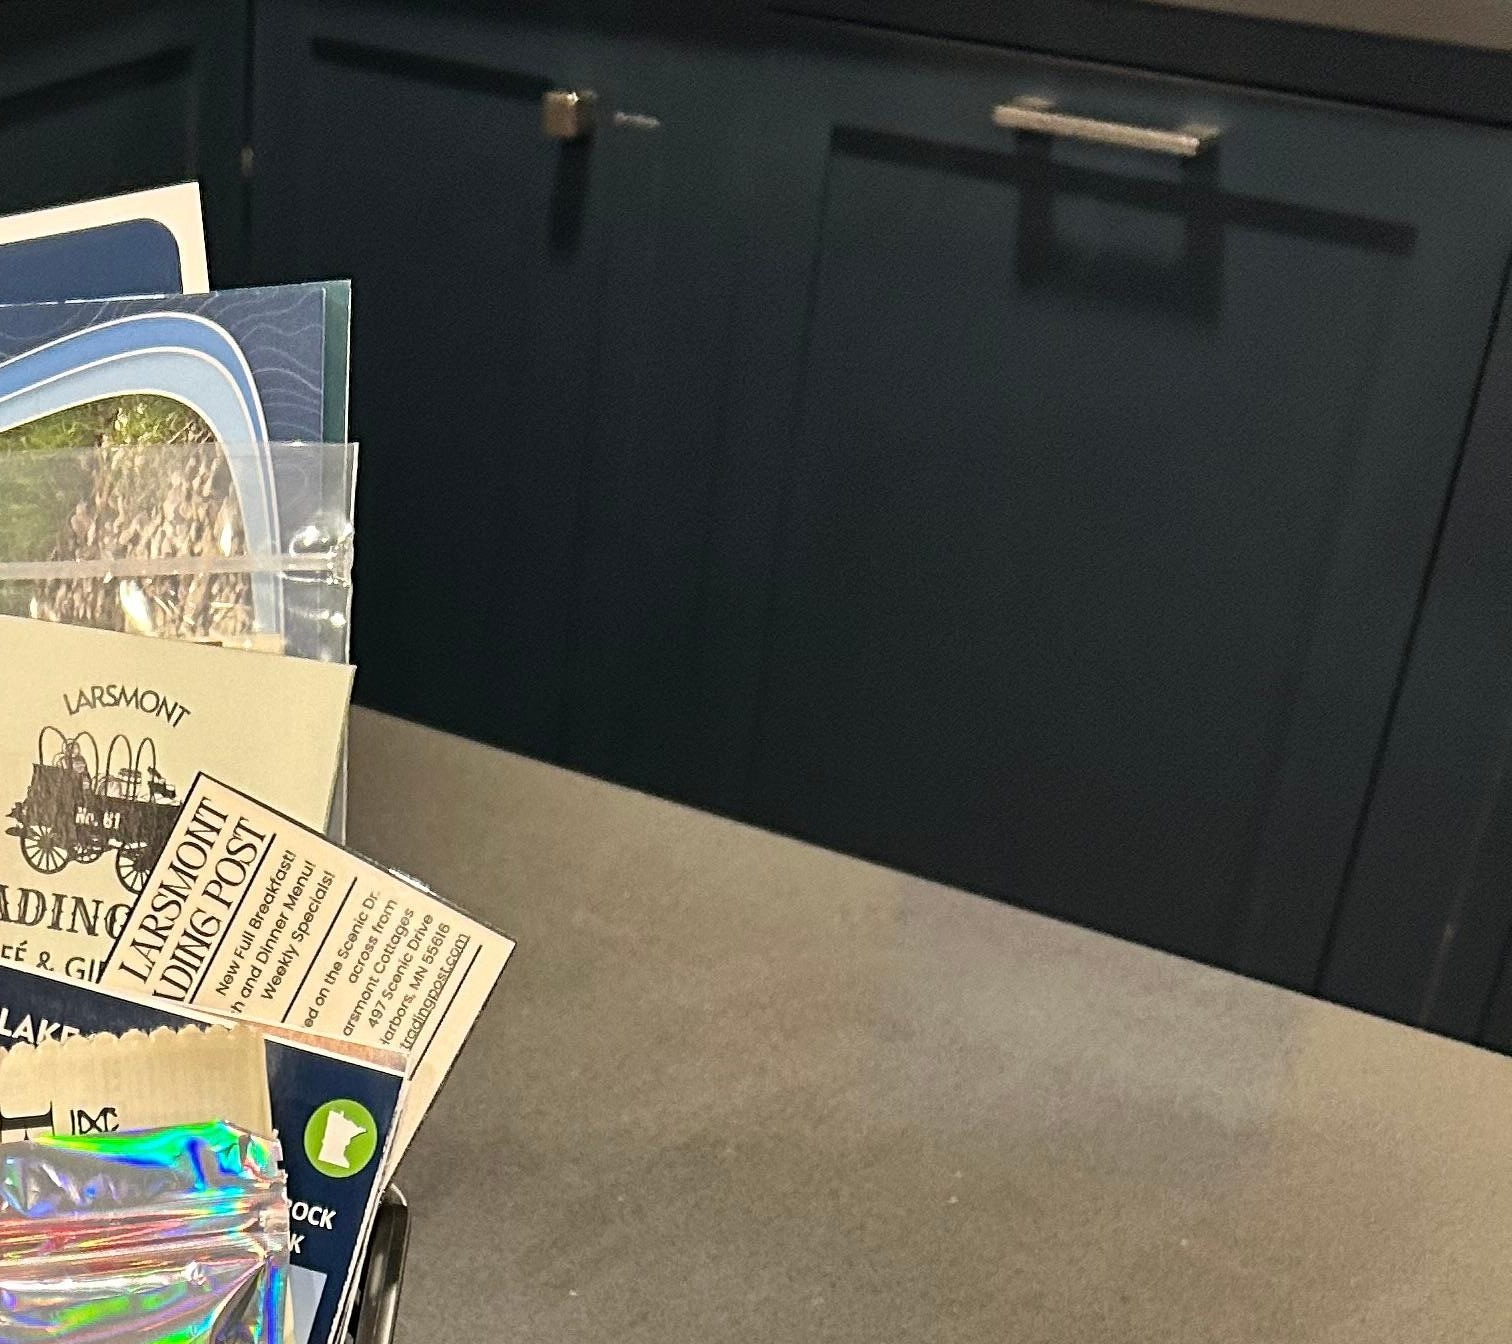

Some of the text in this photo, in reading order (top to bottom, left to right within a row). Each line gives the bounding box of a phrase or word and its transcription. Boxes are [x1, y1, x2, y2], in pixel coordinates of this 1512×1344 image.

[63, 684, 192, 729] LARSMONT
[118, 797, 228, 985] LARSMONT
[202, 816, 267, 911] POST
[234, 931, 257, 961] Full
[248, 849, 297, 929] Breakfast!
[239, 860, 317, 999] and Dinner Menu!
[261, 870, 336, 1001] Weekly Specials!
[315, 890, 382, 1007] on the Scenic Dr.
[348, 898, 398, 984] across from
[368, 913, 434, 1029] 497 Scenic Drive
[373, 908, 415, 975] Cottages
[409, 922, 451, 991] MN 55616
[287, 1199, 337, 1230] OCK
